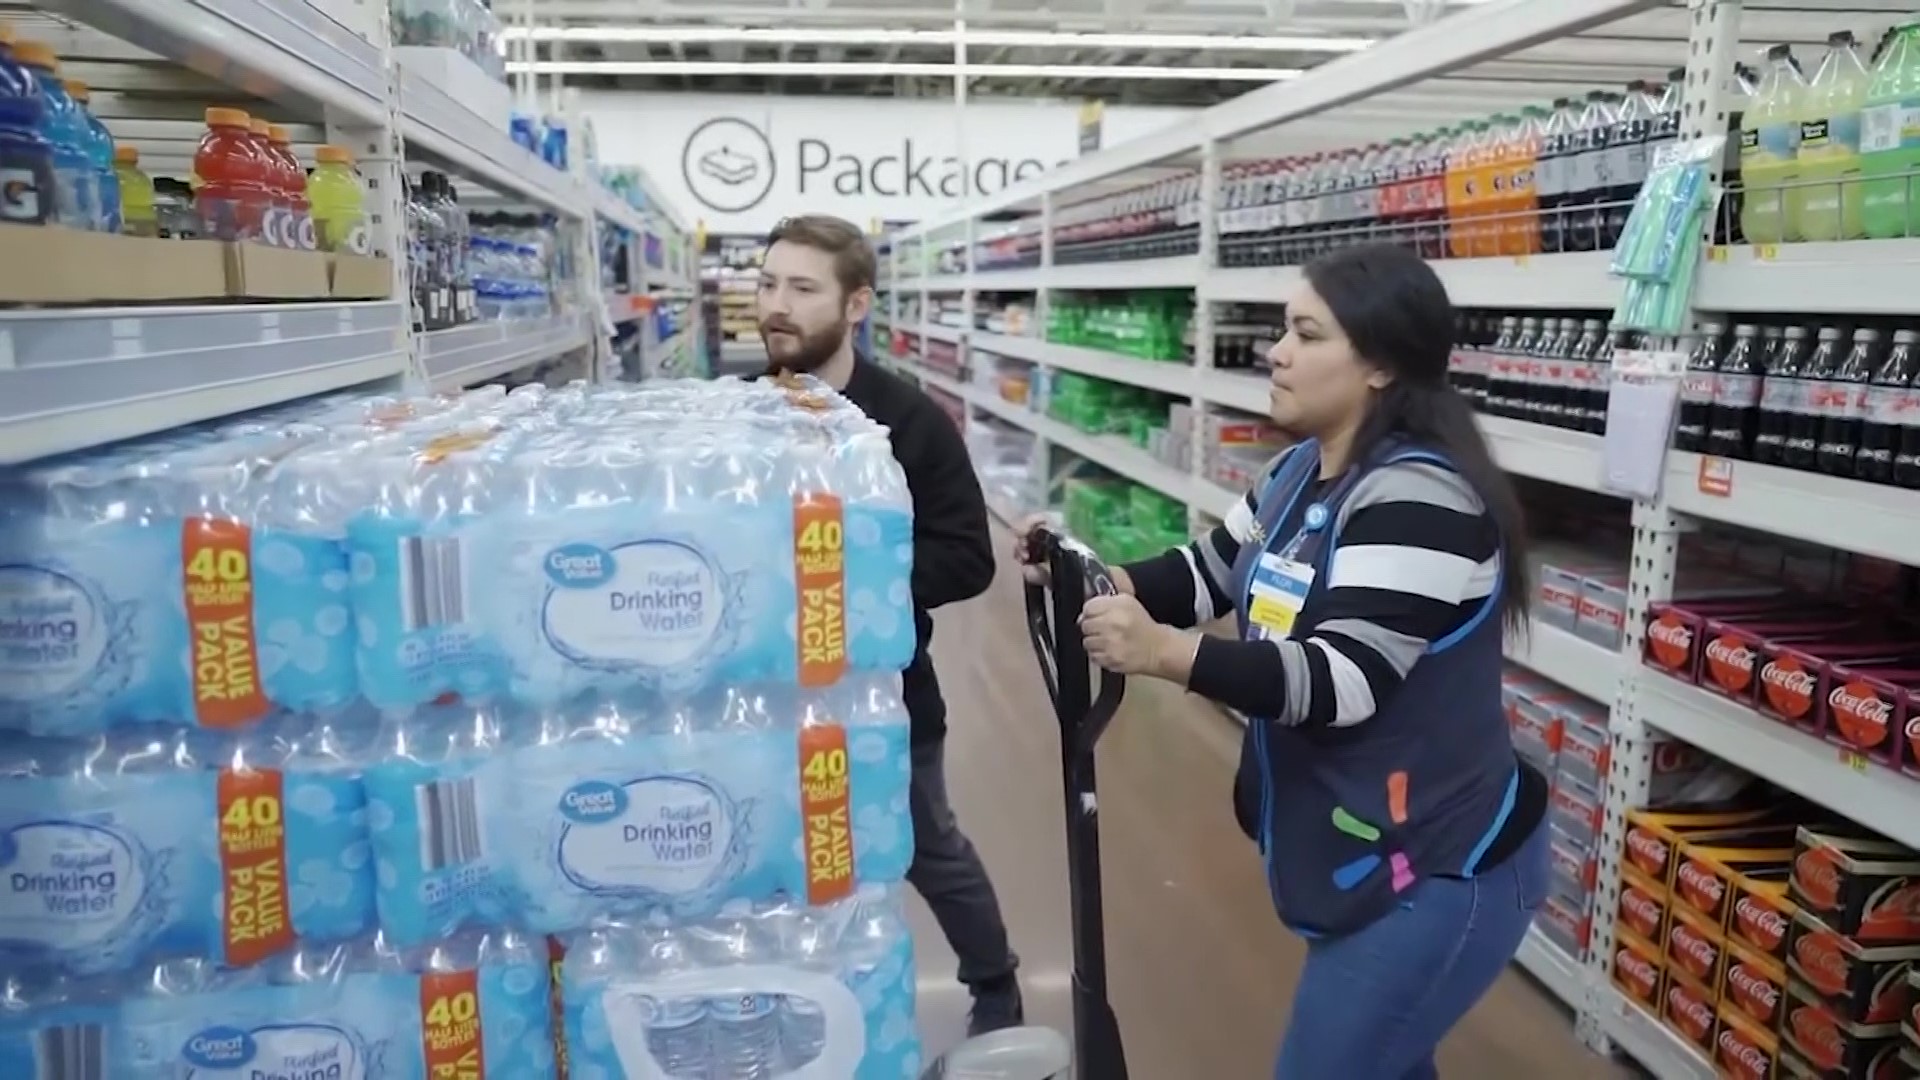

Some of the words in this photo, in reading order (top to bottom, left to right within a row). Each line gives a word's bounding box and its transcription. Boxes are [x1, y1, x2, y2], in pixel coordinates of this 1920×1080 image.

[798, 521, 842, 552] 40
[186, 548, 247, 582] 40
[552, 552, 601, 570] Great
[610, 590, 702, 612] Drinking
[639, 611, 703, 631] Water
[803, 589, 825, 664] PACK
[825, 582, 843, 662] VALUE
[196, 623, 227, 701] PACK
[223, 616, 255, 699] VALUE
[804, 749, 846, 781] 40
[222, 796, 280, 830] 40
[566, 789, 614, 807] Great
[624, 821, 712, 843] Drinking
[830, 806, 851, 881] VALUE
[653, 841, 713, 861] Water
[808, 815, 832, 883] PACK
[11, 871, 115, 893] Drinking
[43, 894, 118, 914] Water
[230, 867, 257, 945] PACK
[254, 859, 284, 939] VALUE
[425, 992, 475, 1026] 40
[190, 1035, 242, 1053] Great
